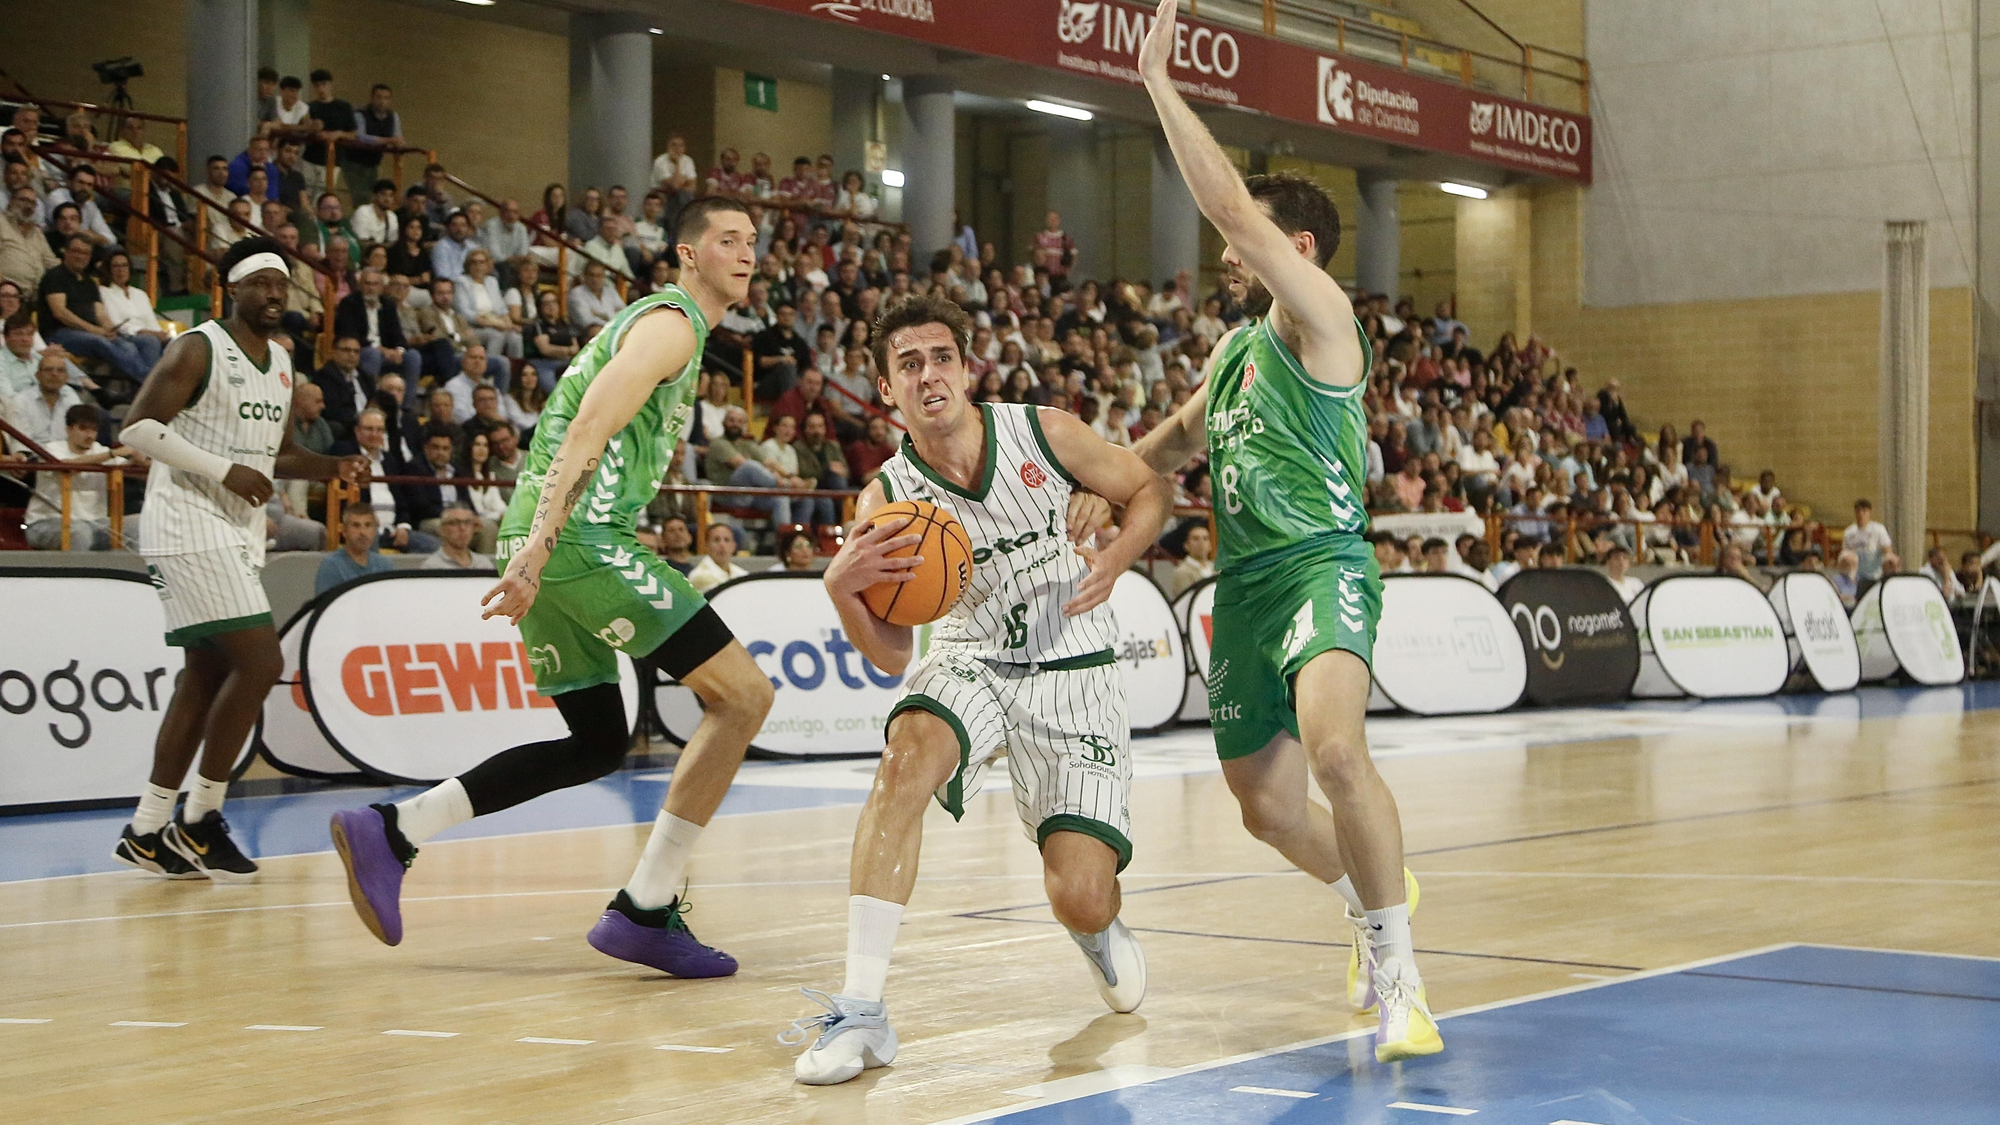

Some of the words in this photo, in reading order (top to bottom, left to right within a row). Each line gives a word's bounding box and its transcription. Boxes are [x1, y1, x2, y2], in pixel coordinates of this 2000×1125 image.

[1102, 3, 1240, 79] IMECO
[757, 80, 766, 105] 1
[1356, 79, 1419, 113] Diputación
[1357, 104, 1373, 126] de
[1495, 103, 1581, 156] IMDECO
[238, 400, 283, 422] coto
[1222, 464, 1243, 515] 8
[972, 531, 1040, 565] oto
[1662, 627, 1693, 641] SAN
[1695, 625, 1774, 640] SEBASTIAN
[1115, 629, 1173, 669] ajasol
[834, 717, 866, 732] con
[1209, 700, 1242, 723] ertic
